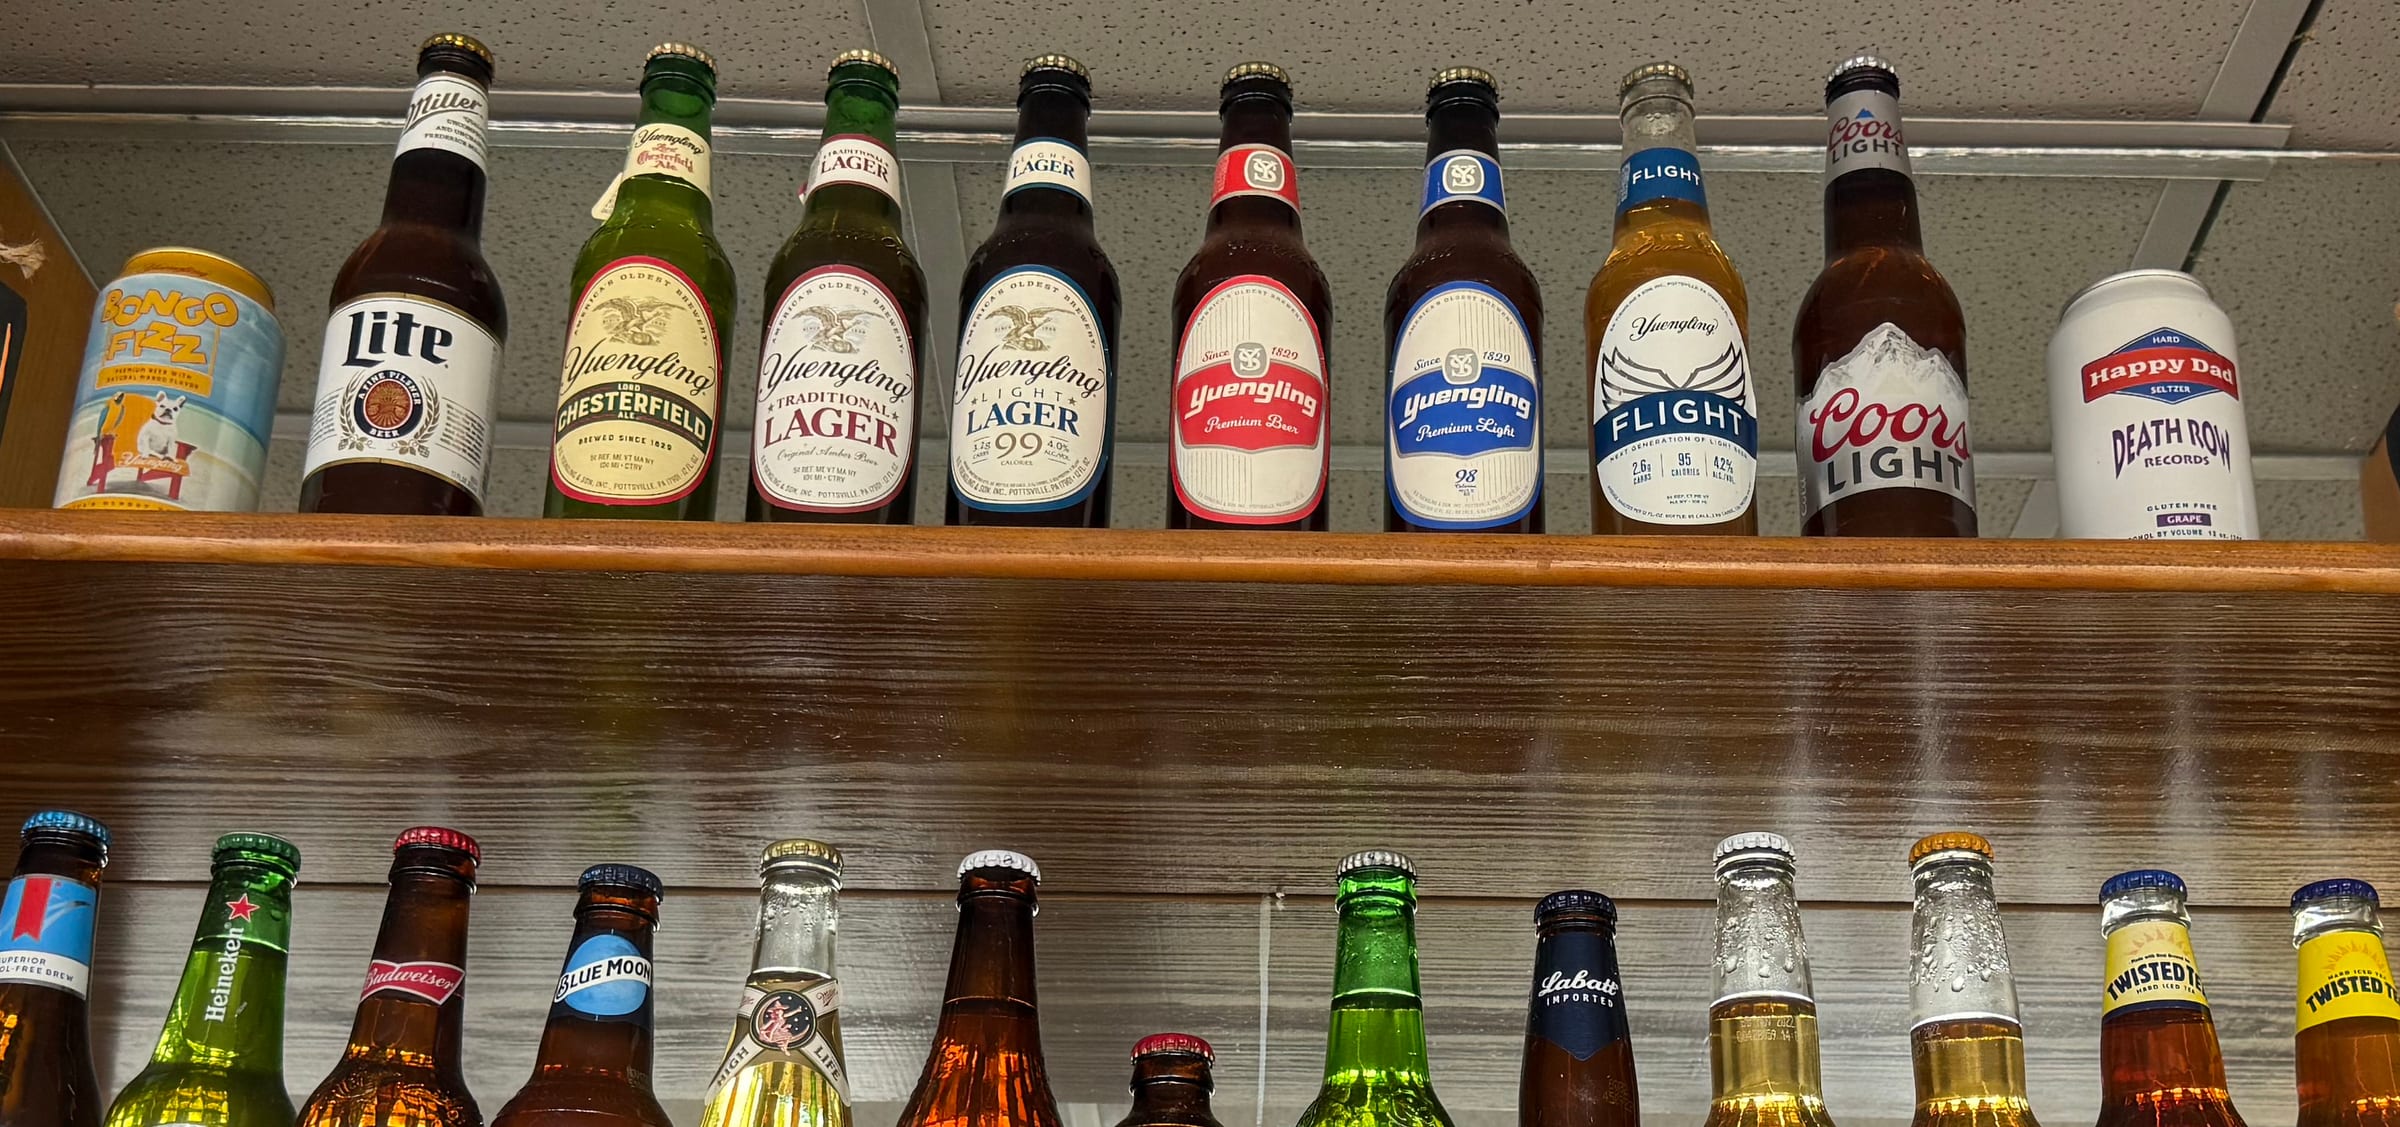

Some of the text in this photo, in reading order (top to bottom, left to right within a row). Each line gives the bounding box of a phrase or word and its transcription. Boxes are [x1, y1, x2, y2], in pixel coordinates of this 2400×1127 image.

[402, 92, 482, 133] Miller
[635, 128, 705, 155] Yuengling
[1829, 117, 1904, 152] Coors
[1832, 139, 1900, 164] LIGHT
[821, 155, 889, 183] LAGER
[1013, 158, 1075, 180] LAGER
[1632, 165, 1700, 186] FLIGHT
[101, 288, 239, 328] BONGO
[620, 272, 671, 287] OLDEST
[676, 289, 707, 342] BREWERY
[819, 282, 869, 296] OLDEST
[873, 298, 904, 353] BREWERY
[1010, 280, 1059, 293] OLDEST
[1064, 295, 1096, 347] BREWERY
[341, 311, 454, 368] Lite
[1629, 313, 1719, 342] Yuengling
[2152, 336, 2180, 344] HARD
[106, 321, 207, 365] FIZZ
[1202, 346, 1299, 363] Since 1829
[560, 337, 716, 396] Yuengling
[759, 345, 913, 404] Yuengling
[955, 345, 1105, 404] Yuengling
[1414, 351, 1511, 371] Since 1829
[2090, 357, 2234, 387] Happy Dad
[389, 371, 422, 405] PILSNER
[618, 383, 641, 392] LORD
[982, 386, 1063, 402] LIGHT
[1184, 380, 1317, 420] Yuengling
[2150, 385, 2191, 394] SELTZER
[558, 391, 706, 442] CHESTERFIELD
[617, 411, 635, 420] ALE
[776, 392, 890, 418] TRADITIONAL
[967, 401, 1080, 437] LAGER
[1399, 384, 1531, 430] Yuengling
[369, 429, 400, 437] BEER
[764, 407, 898, 458] LAGER
[1204, 413, 1299, 434] Premium Beer
[1416, 418, 1515, 442] Premium Light
[1612, 399, 1742, 442] FLIGHT
[1809, 387, 1970, 463] Coors
[578, 434, 673, 451] BREWED SINCE 1829
[995, 432, 1043, 459] 99
[1631, 436, 1691, 452] GENERATION
[1709, 439, 1732, 449] LIGHT
[2112, 418, 2231, 479] DEATH ROW
[1678, 452, 1692, 466] 95
[1827, 446, 1964, 495] LIGHT
[2144, 454, 2210, 468] RECORDS
[1455, 469, 1478, 484] 98
[2147, 502, 2189, 512] GLUTEN
[2167, 515, 2203, 524] GRAPE
[45, 969, 74, 982] BREW
[204, 927, 244, 1023] Heineken
[366, 968, 455, 989] Budweiser
[556, 958, 651, 999] BLUE MOON
[1538, 970, 1619, 997] Labatt
[2107, 961, 2206, 1001] TWISTED TE
[1546, 993, 1614, 1008] IMPORTED
[2305, 975, 2384, 1013] TWISTED
[717, 1046, 841, 1087] HIGH LIFE
